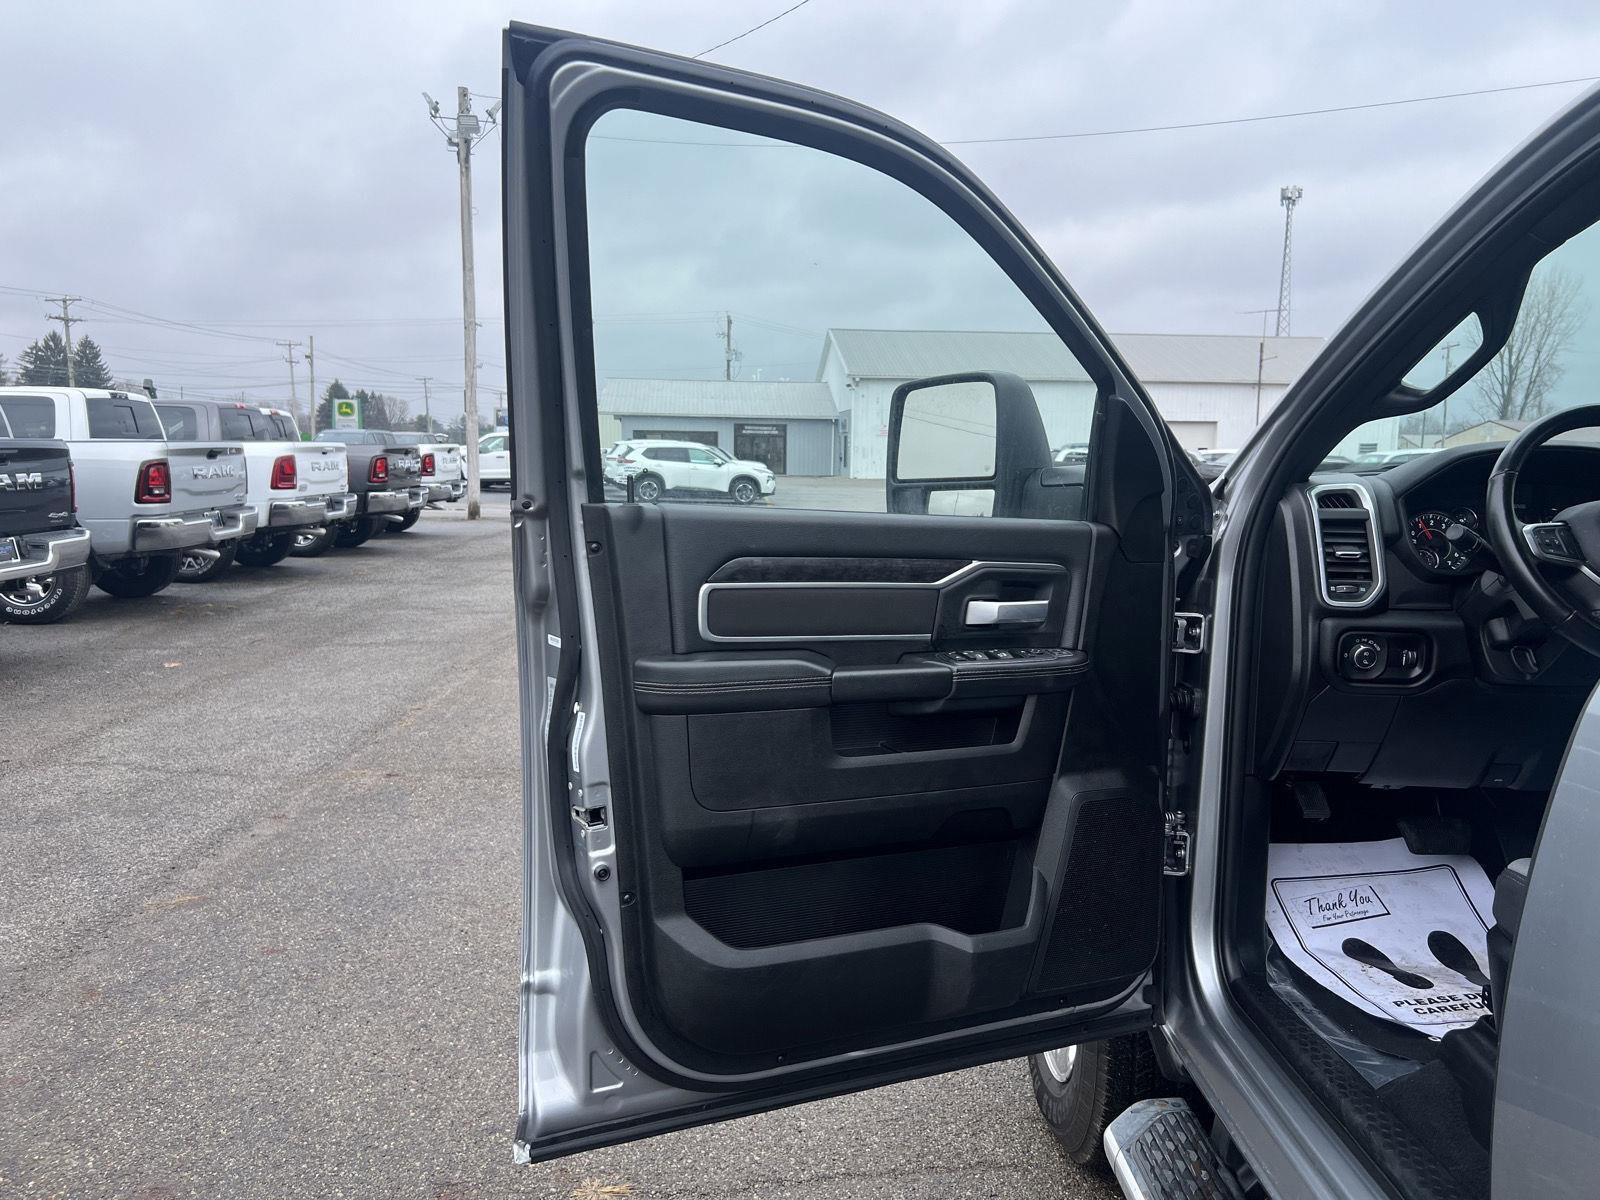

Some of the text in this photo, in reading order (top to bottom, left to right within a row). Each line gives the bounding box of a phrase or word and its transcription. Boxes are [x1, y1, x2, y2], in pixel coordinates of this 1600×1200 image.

[192, 464, 235, 480] RAM
[311, 461, 339, 471] RAM
[0, 472, 43, 491] AM
[1304, 889, 1373, 915] Thank You
[1392, 994, 1462, 1008] PLEASE
[1413, 1001, 1484, 1015] CAREFU
